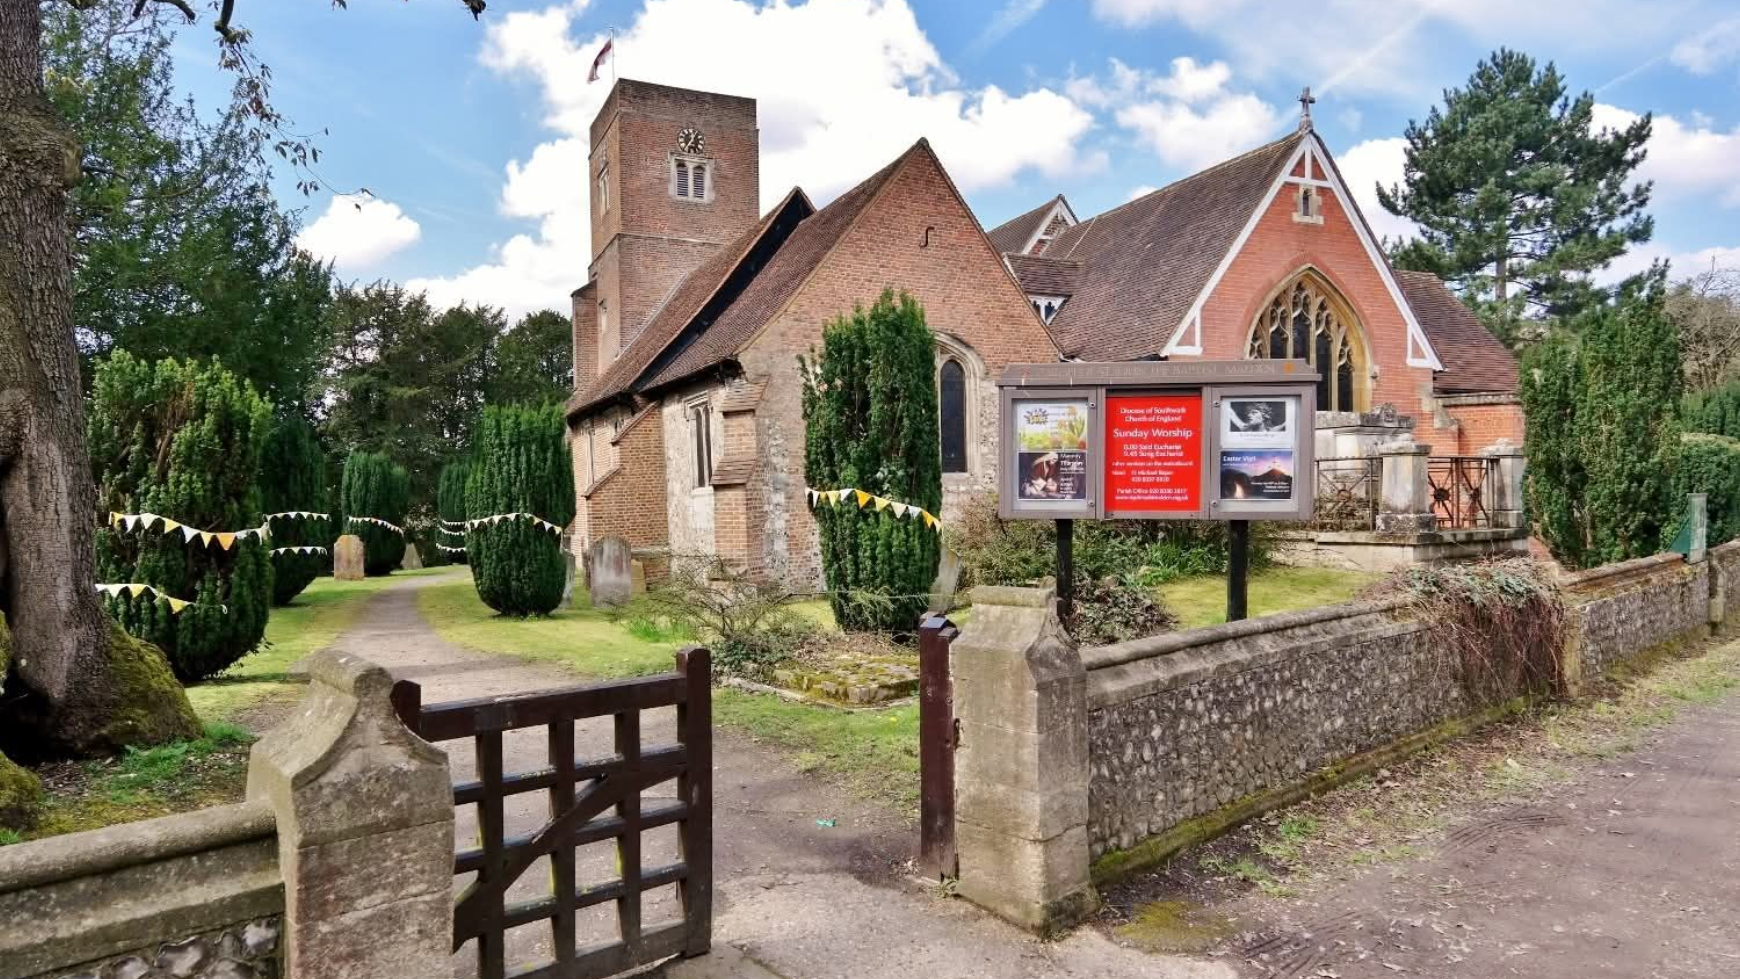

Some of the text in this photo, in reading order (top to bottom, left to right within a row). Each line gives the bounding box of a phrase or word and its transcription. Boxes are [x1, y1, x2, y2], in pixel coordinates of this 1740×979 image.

[1157, 415, 1182, 423] England
[1113, 428, 1193, 439] Sunday Worship
